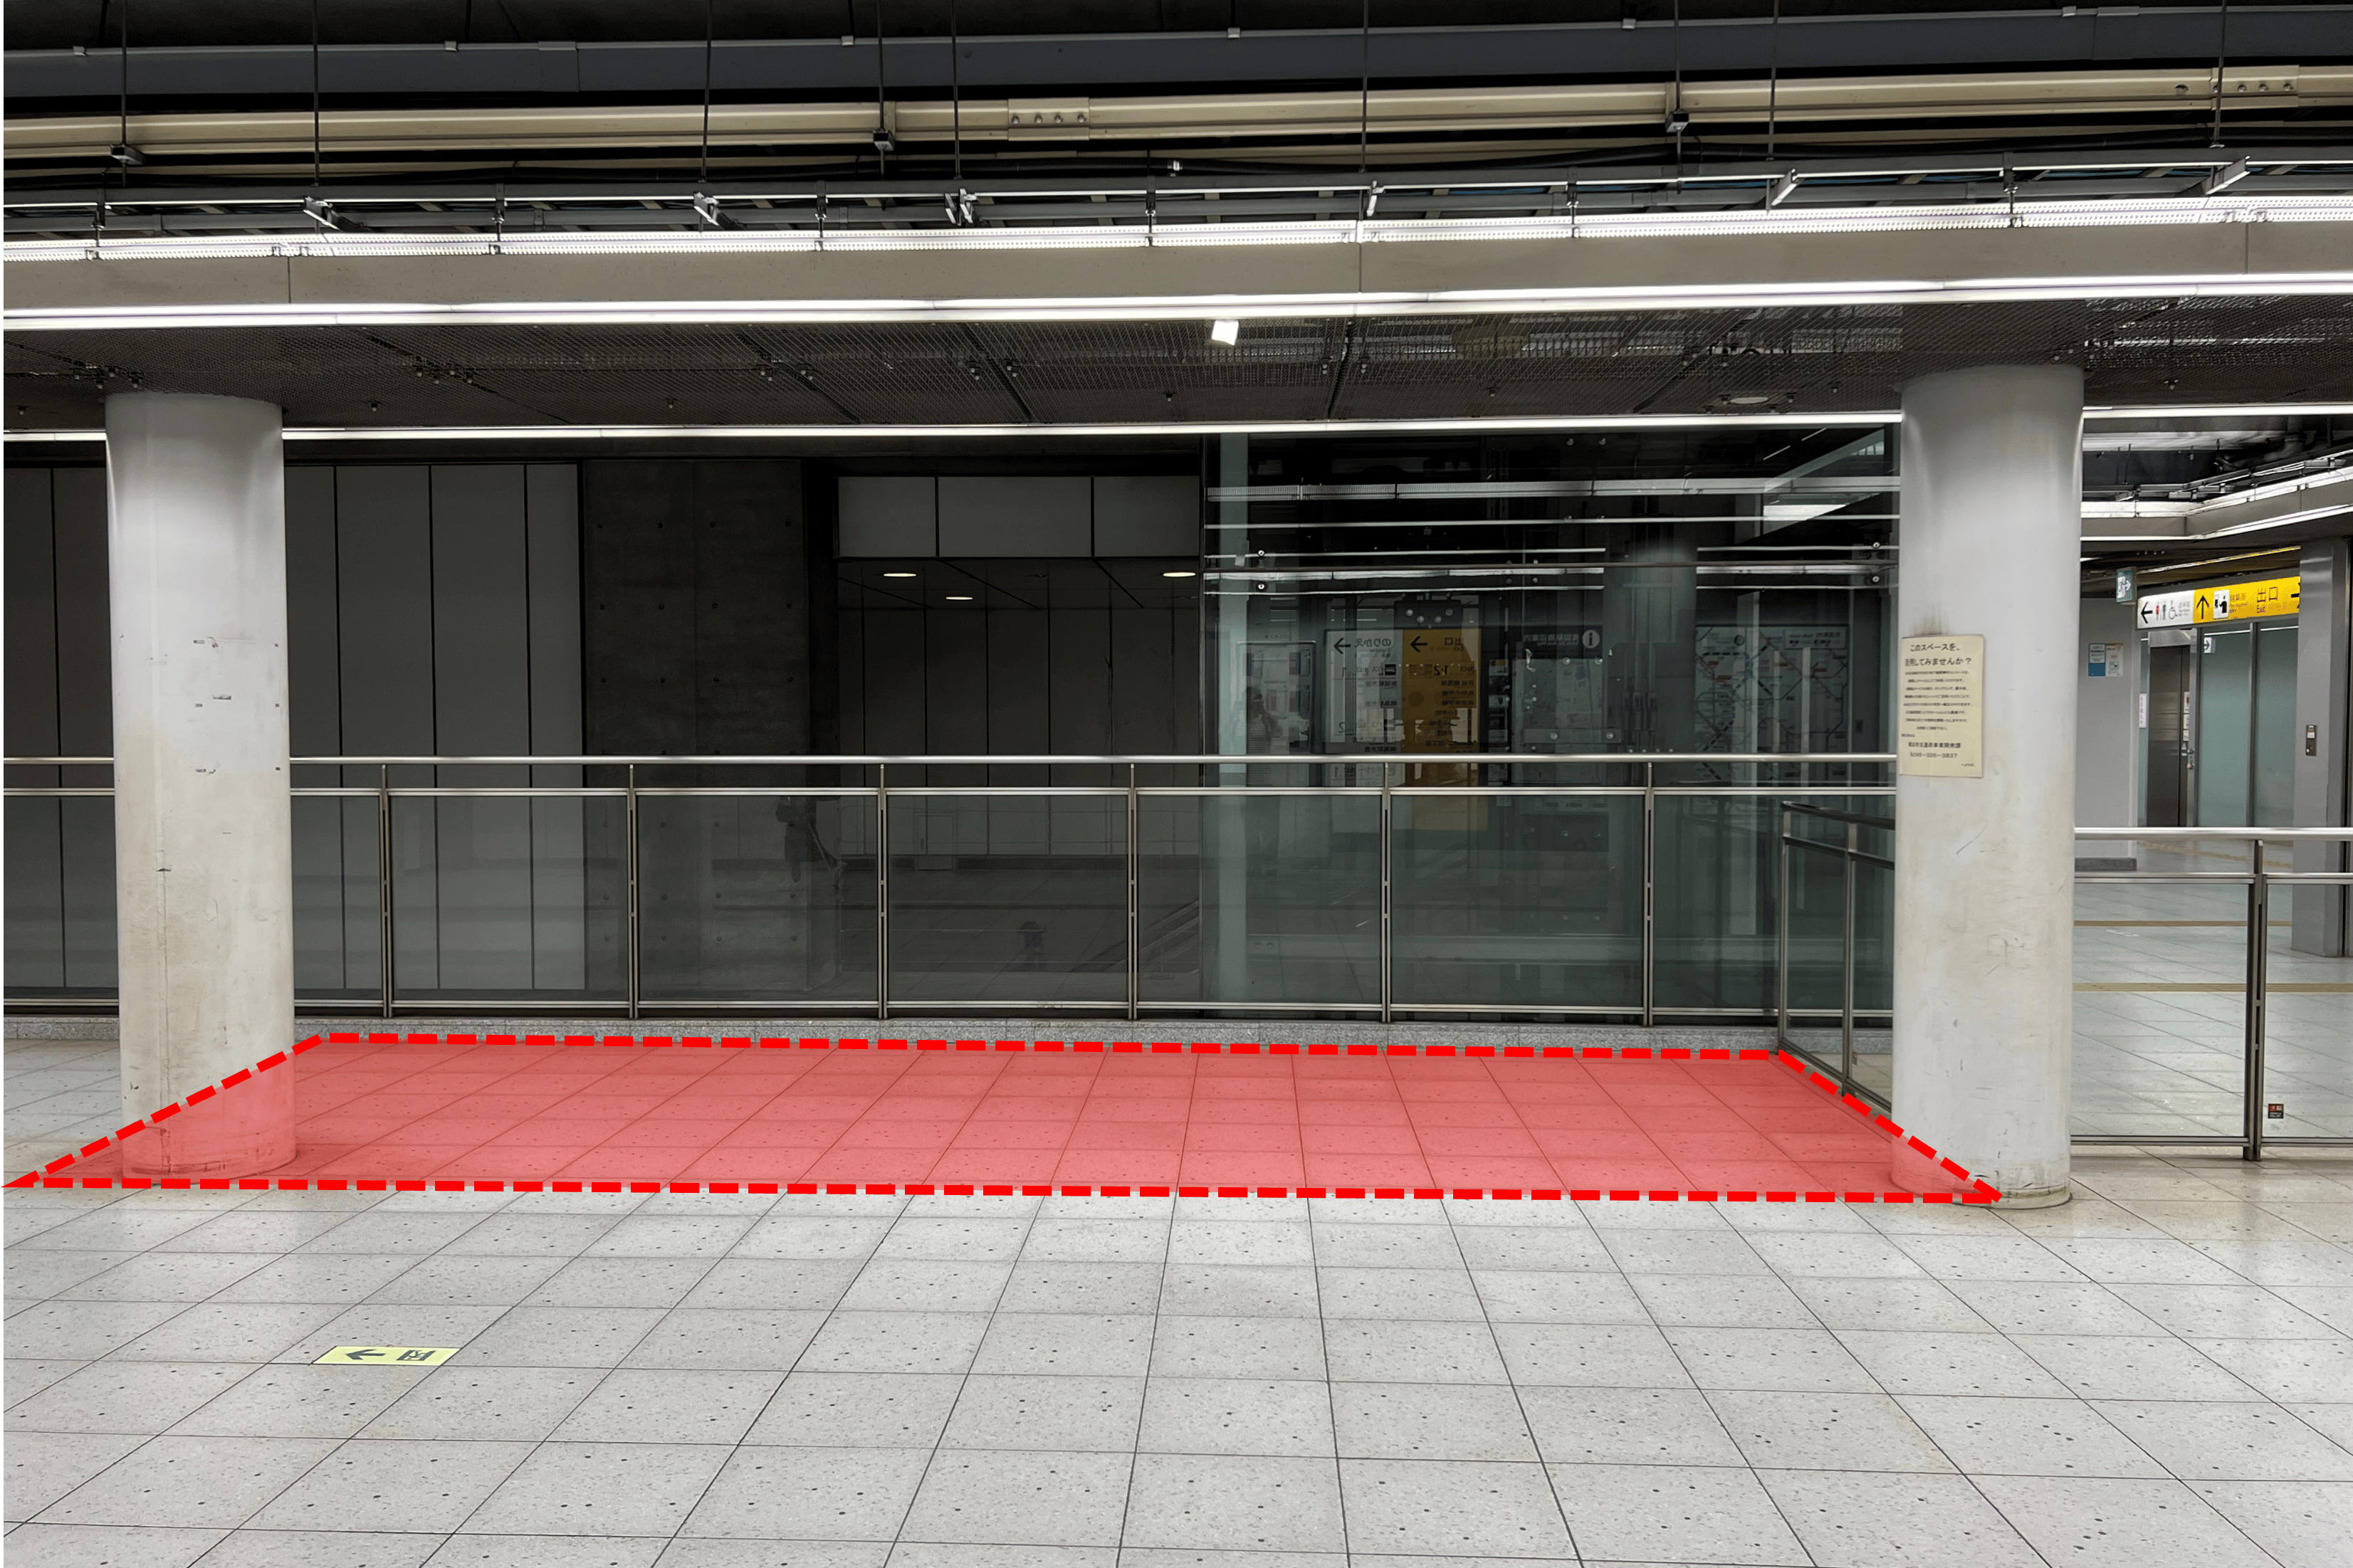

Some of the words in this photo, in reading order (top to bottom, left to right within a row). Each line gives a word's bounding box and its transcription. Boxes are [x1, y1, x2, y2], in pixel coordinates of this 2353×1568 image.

[2256, 586, 2278, 602] 出口
[1910, 643, 1960, 652] このスペースを、
